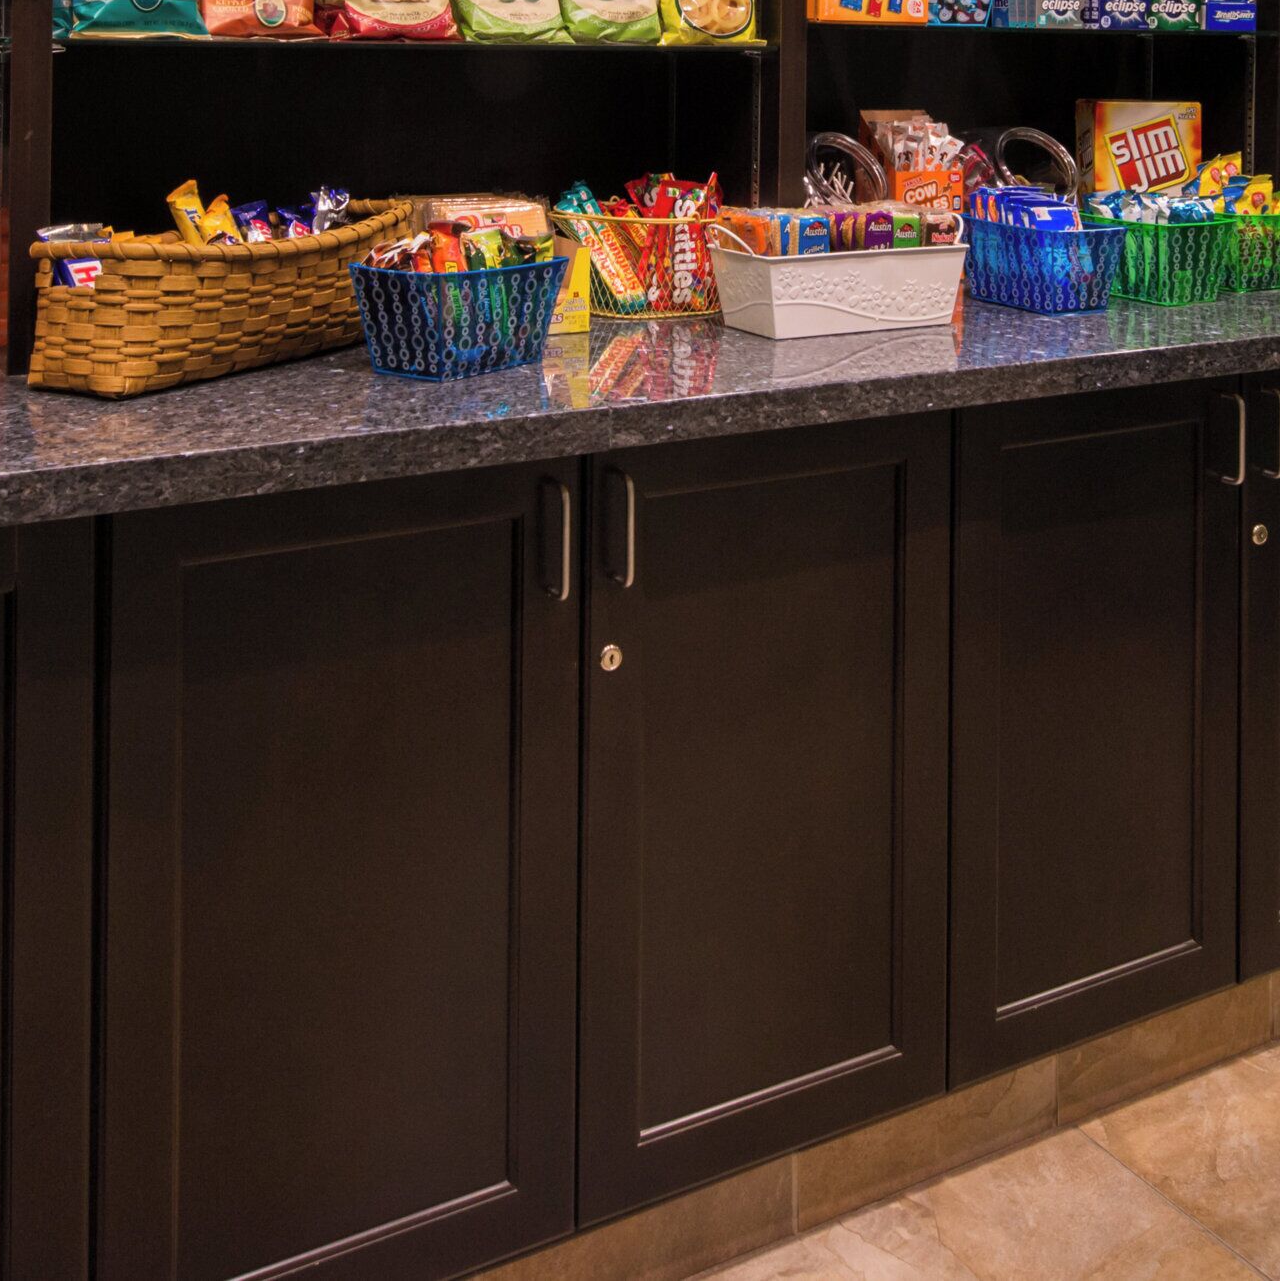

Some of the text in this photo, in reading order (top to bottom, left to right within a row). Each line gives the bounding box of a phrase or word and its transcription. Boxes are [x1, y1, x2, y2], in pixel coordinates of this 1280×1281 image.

[1042, 0, 1080, 12] eclipse
[1105, 0, 1146, 14] eclipse
[1151, 1, 1196, 15] eclipse
[1110, 125, 1180, 166] slim
[1130, 148, 1188, 194] jim
[905, 181, 937, 204] COW
[803, 225, 828, 238] Austin
